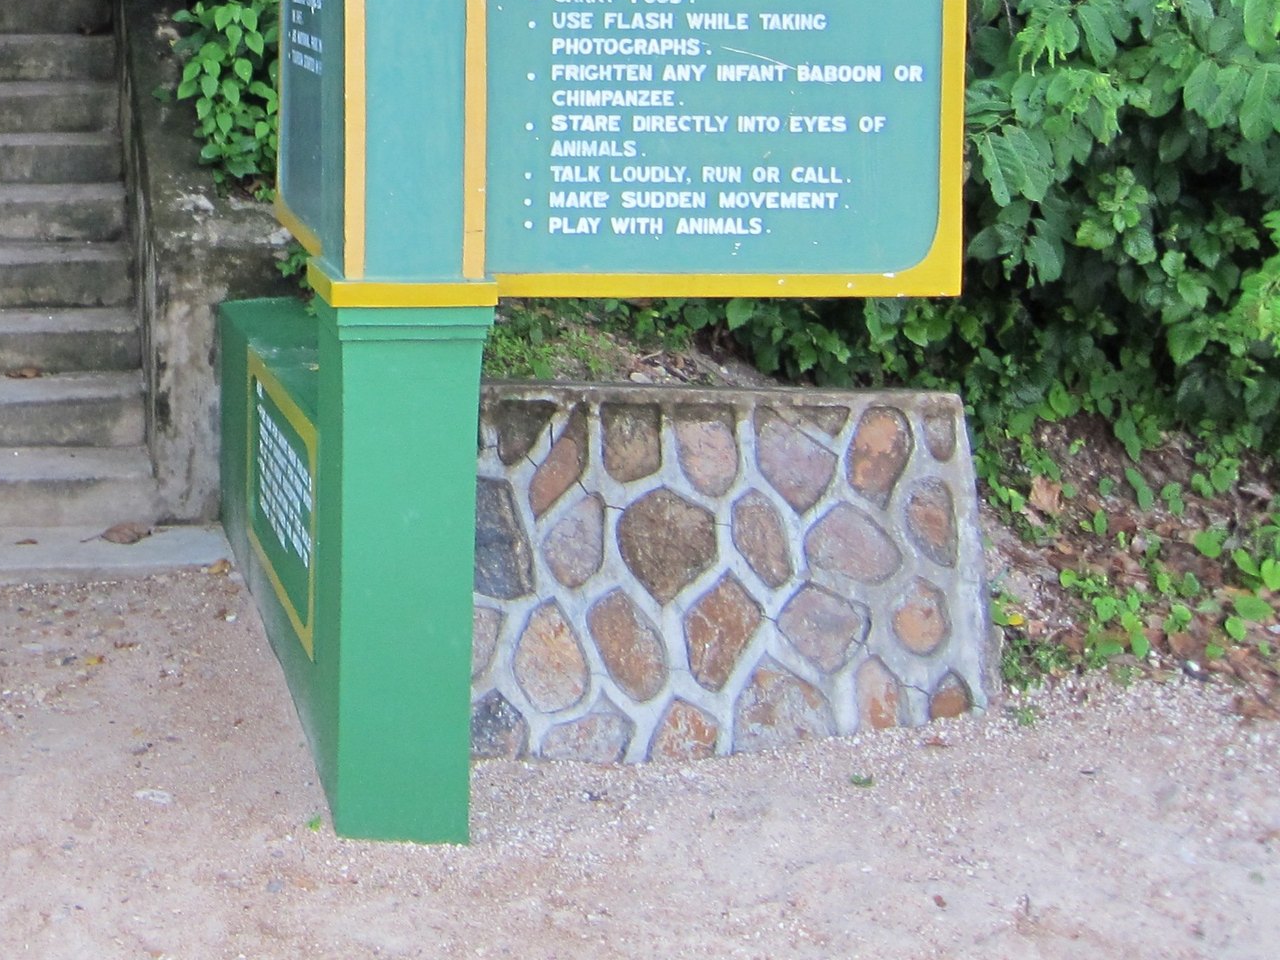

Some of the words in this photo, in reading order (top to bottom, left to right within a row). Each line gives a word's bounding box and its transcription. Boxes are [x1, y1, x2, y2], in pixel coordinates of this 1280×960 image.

[552, 12, 594, 31] USE
[604, 12, 673, 31] FLASH
[686, 12, 749, 31] WHILE
[758, 12, 827, 31] TAKING
[551, 37, 712, 57] PHOTOGRAPHS.
[551, 63, 653, 83] FRIGHTEN
[662, 63, 707, 83] ANY
[716, 63, 787, 83] INFANT
[797, 63, 882, 83] BABOON
[893, 63, 923, 83] OR
[551, 89, 684, 108] CHIMPANZEE.
[551, 114, 622, 133] STARE
[632, 114, 729, 133] DIRECTLY
[737, 114, 781, 133] INTO
[789, 114, 847, 133] EYES
[858, 114, 886, 133] OF
[550, 139, 646, 158] ANIMALS.
[549, 165, 601, 184] TALK
[610, 165, 692, 186] LOUDLY,
[702, 165, 742, 184] RUN
[752, 165, 780, 184] OR
[790, 165, 851, 184] CALL.
[549, 191, 609, 210] MAKE
[620, 191, 706, 210] SUDDEN
[548, 216, 601, 235] PLAY
[610, 216, 664, 235] WITH
[675, 216, 771, 235] ANIMALS.
